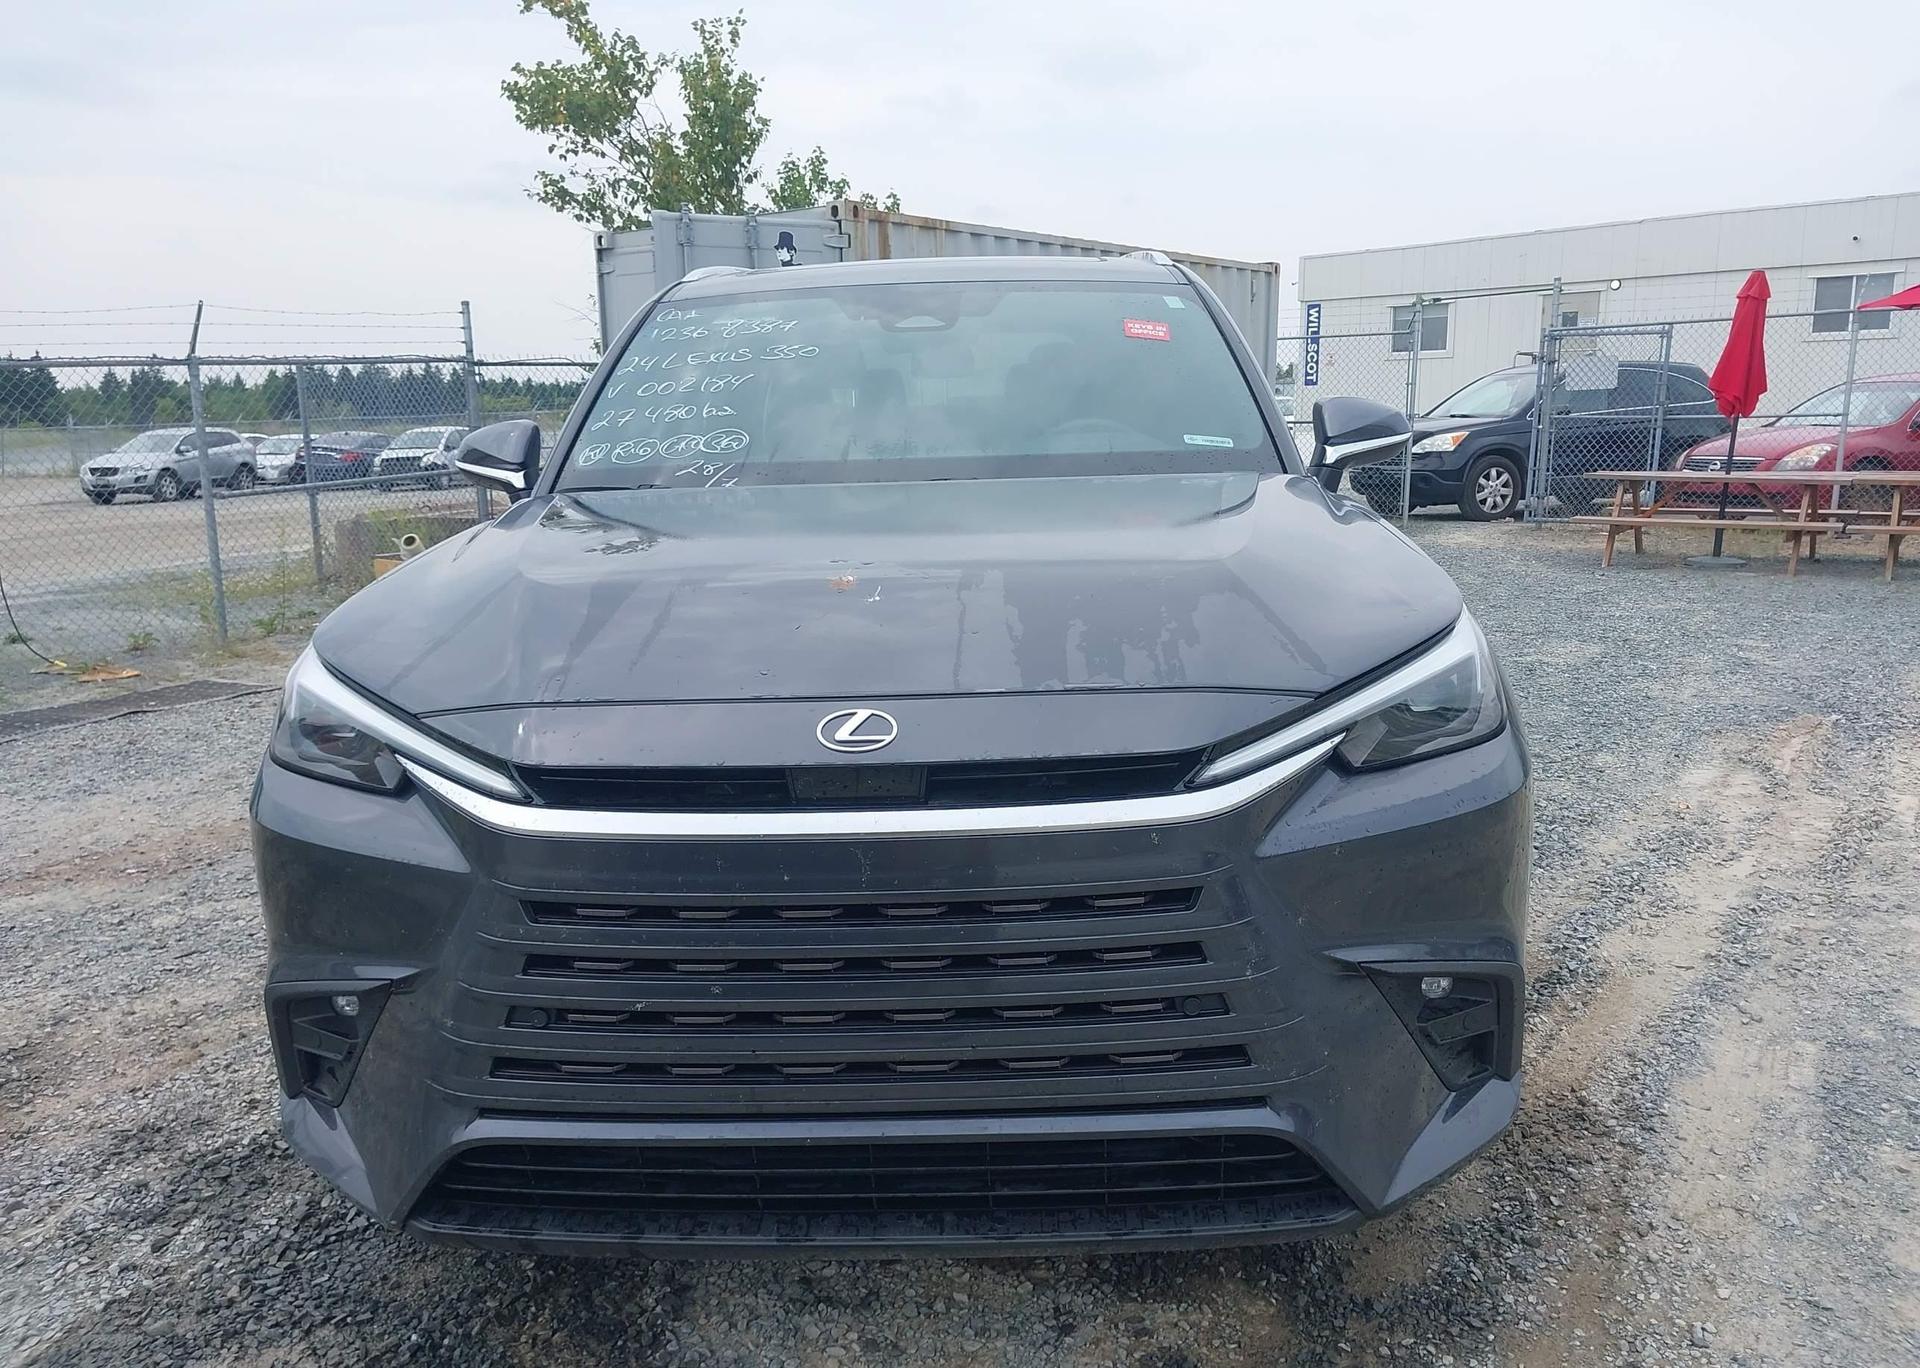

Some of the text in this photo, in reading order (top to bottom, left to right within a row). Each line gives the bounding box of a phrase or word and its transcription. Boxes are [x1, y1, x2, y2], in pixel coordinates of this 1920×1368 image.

[652, 327, 708, 341] 1236
[1131, 328, 1165, 336] OFFICE
[1306, 307, 1319, 382] WILSCOT
[617, 345, 819, 375] 24 LEXUS 350
